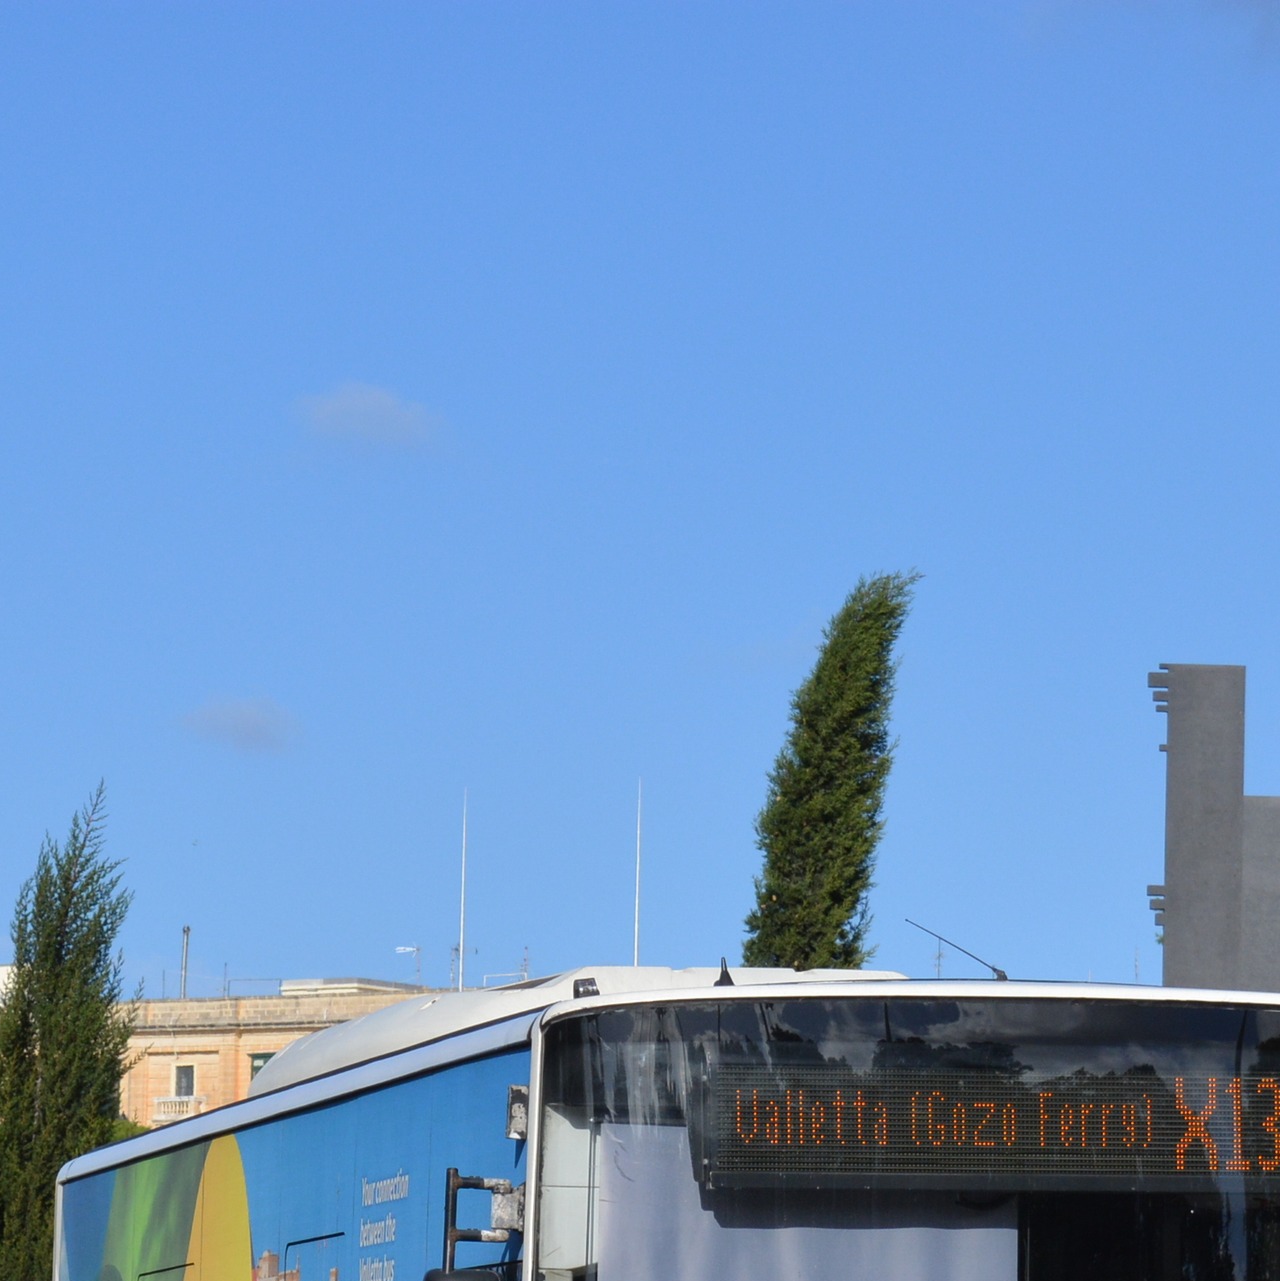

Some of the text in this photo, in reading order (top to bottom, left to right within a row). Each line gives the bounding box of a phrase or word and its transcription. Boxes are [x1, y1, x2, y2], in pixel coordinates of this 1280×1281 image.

[735, 1089, 888, 1146] Valletta
[911, 1090, 1016, 1147] (Gozo
[1039, 1091, 1153, 1148] Ferry)
[361, 1167, 409, 1207] Your connection
[360, 1212, 396, 1248] between the
